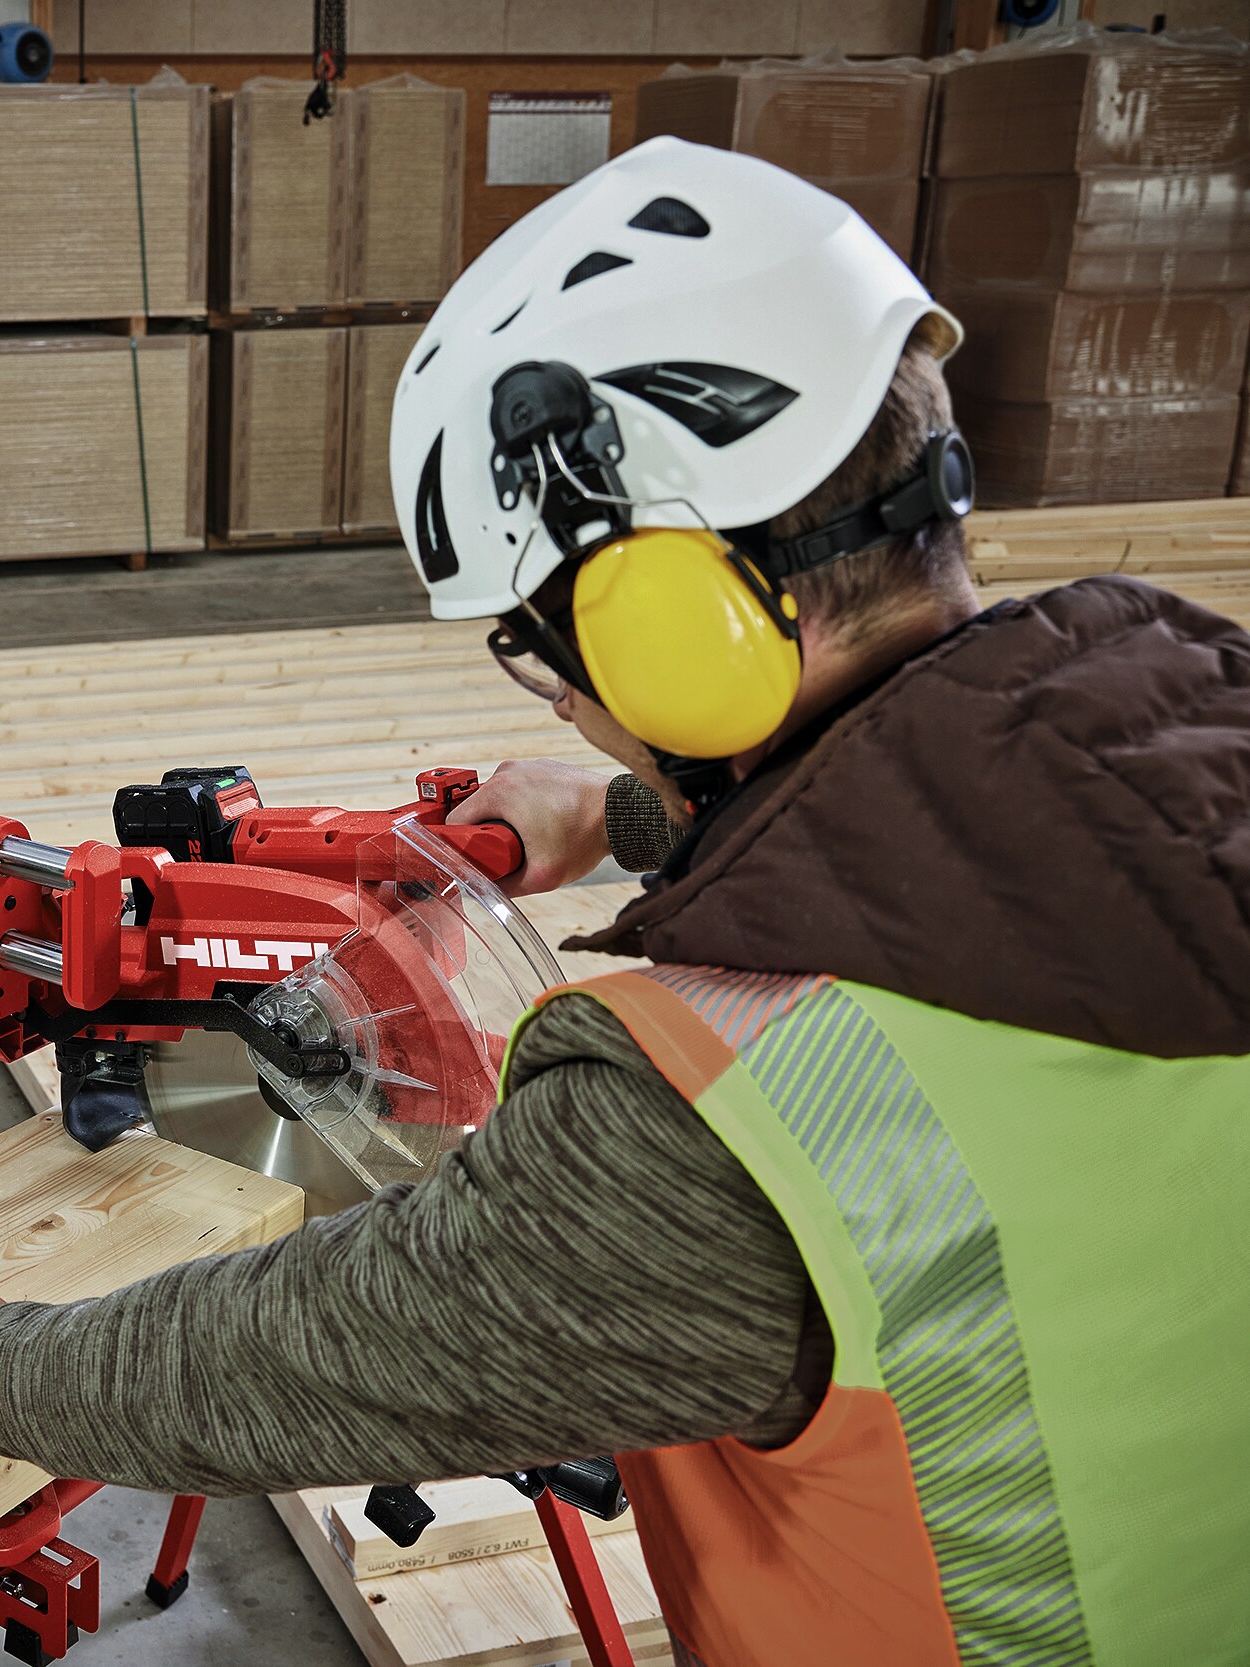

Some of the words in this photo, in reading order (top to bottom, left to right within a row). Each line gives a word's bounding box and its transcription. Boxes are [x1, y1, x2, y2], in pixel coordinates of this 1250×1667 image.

[484, 1543, 501, 1553] 6.2
[503, 1538, 530, 1551] FWT
[448, 1547, 475, 1561] 5508
